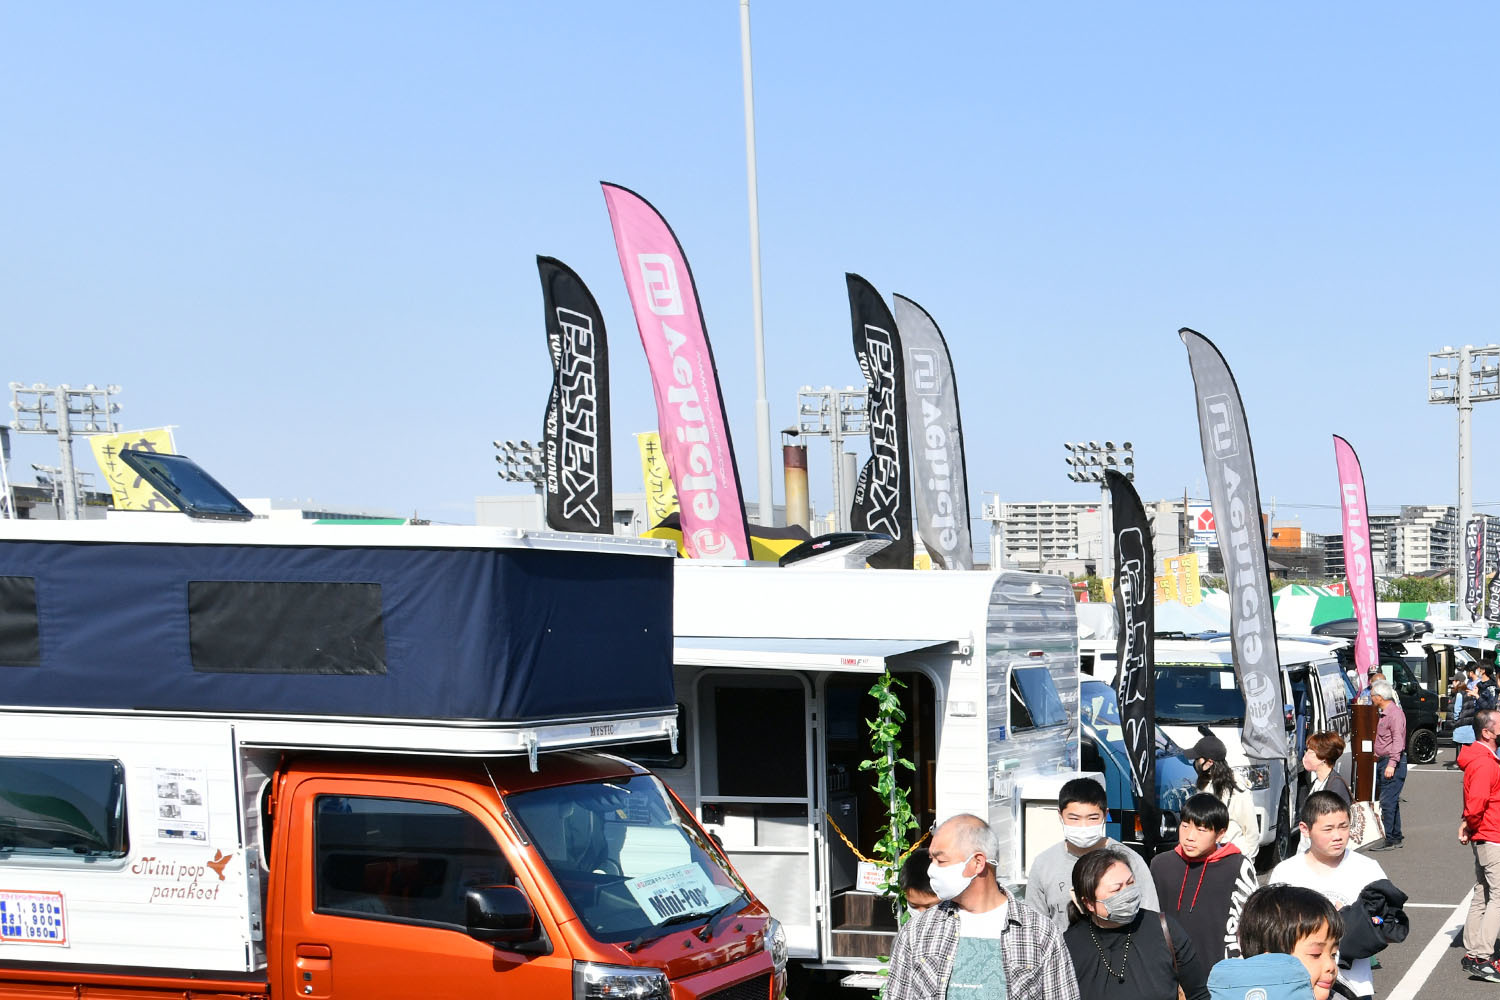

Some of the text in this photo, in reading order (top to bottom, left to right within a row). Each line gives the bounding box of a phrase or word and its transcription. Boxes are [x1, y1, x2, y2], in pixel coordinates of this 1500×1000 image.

[547, 441, 559, 494] CHOICE
[131, 856, 205, 883] Mini pop
[149, 882, 220, 904] parakeet
[648, 887, 709, 919] Mini-Pop
